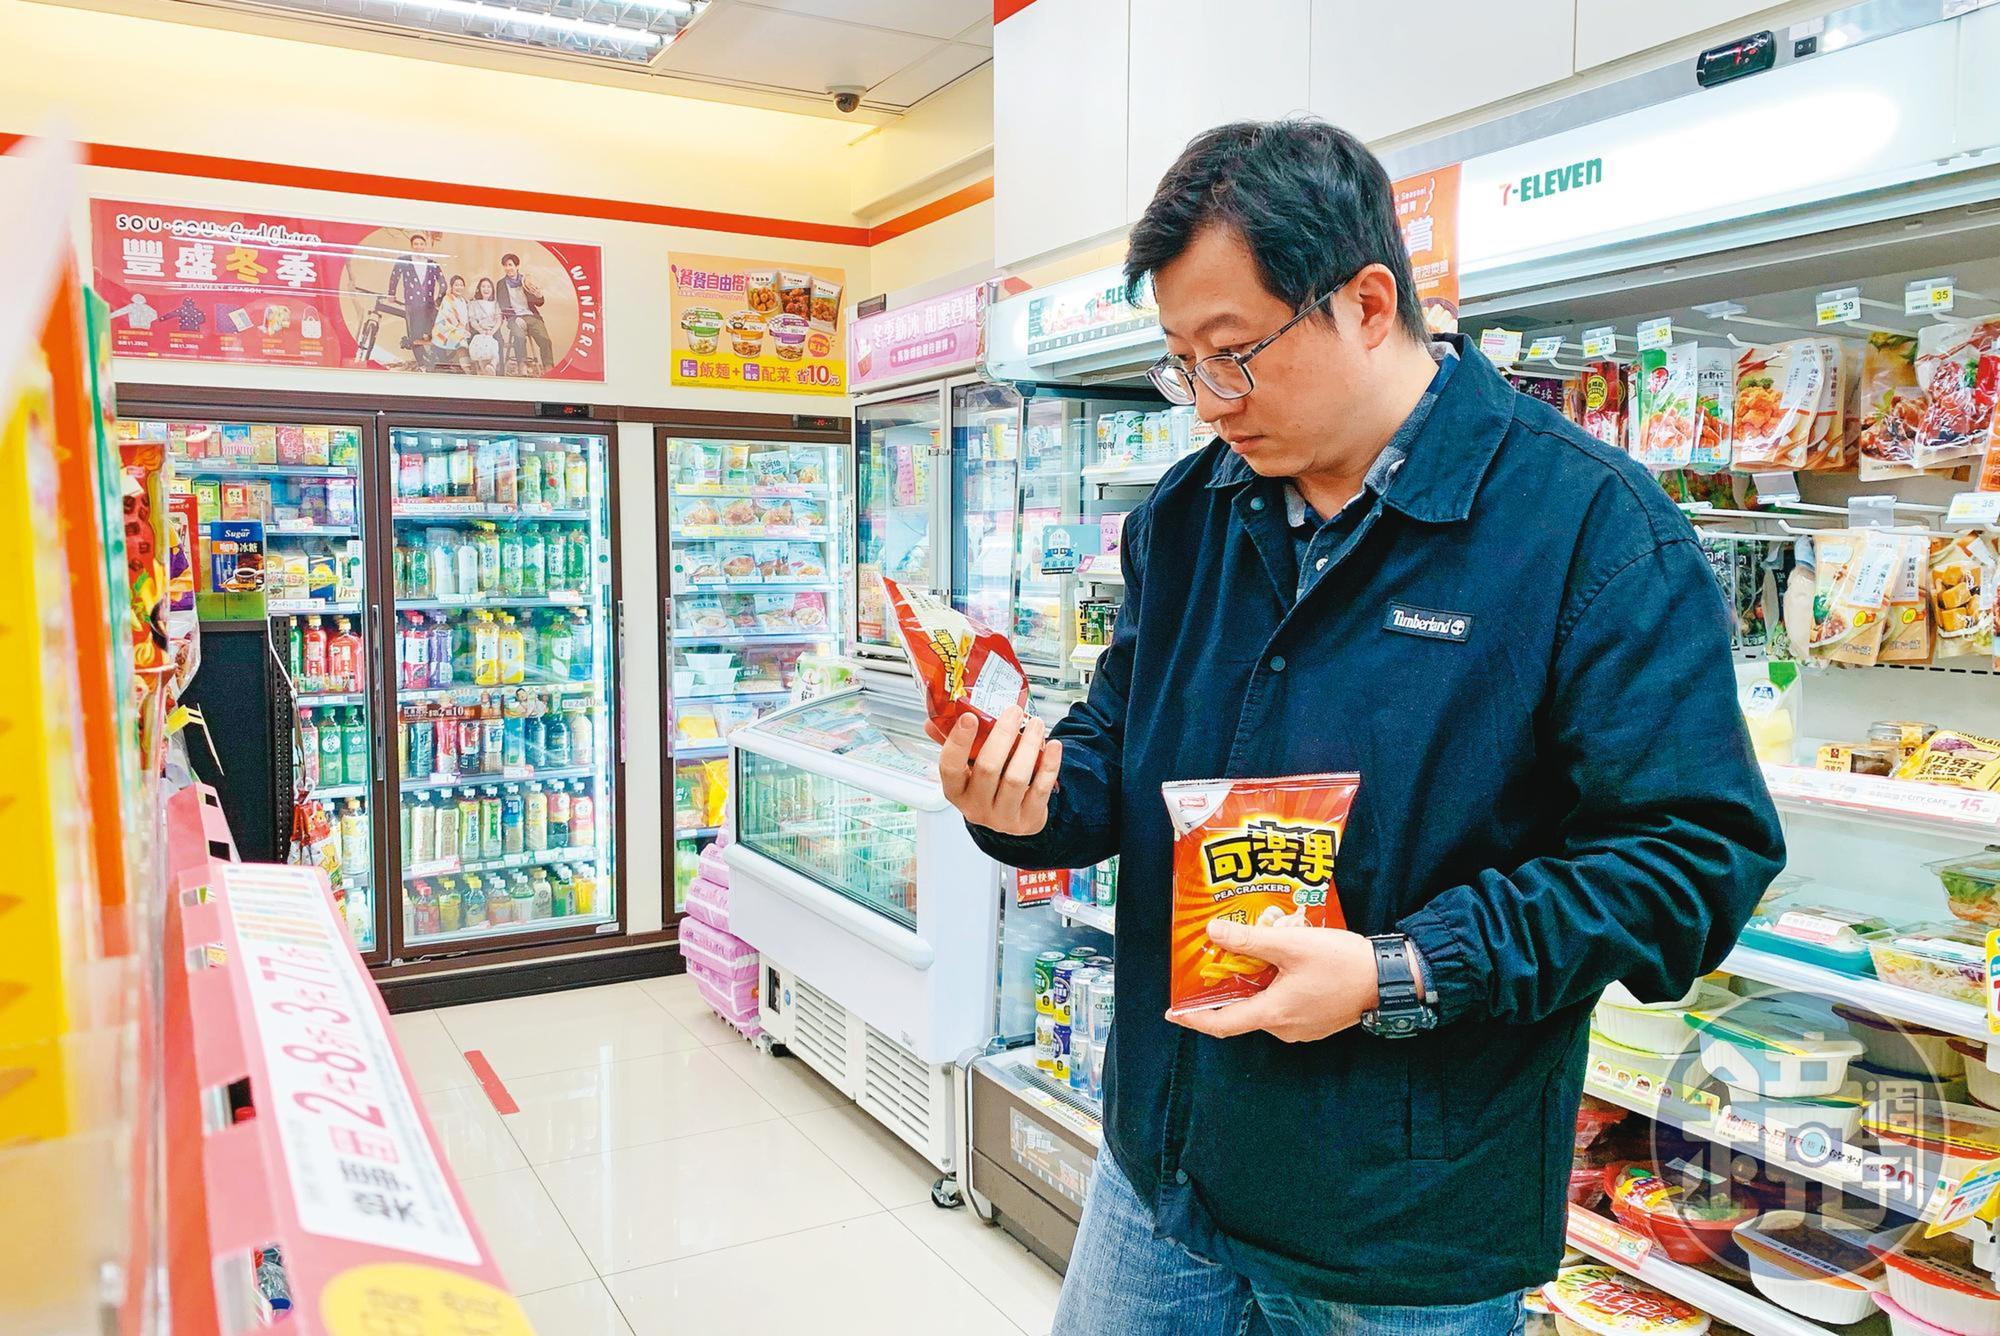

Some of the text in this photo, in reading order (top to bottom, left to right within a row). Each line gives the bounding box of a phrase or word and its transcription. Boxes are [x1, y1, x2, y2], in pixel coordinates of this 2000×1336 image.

[122, 238, 318, 288] 豐盛冬季
[224, 529, 251, 539] Sugar
[1393, 609, 1453, 634] Timberland
[1213, 884, 1291, 902] PEA CRACKERS
